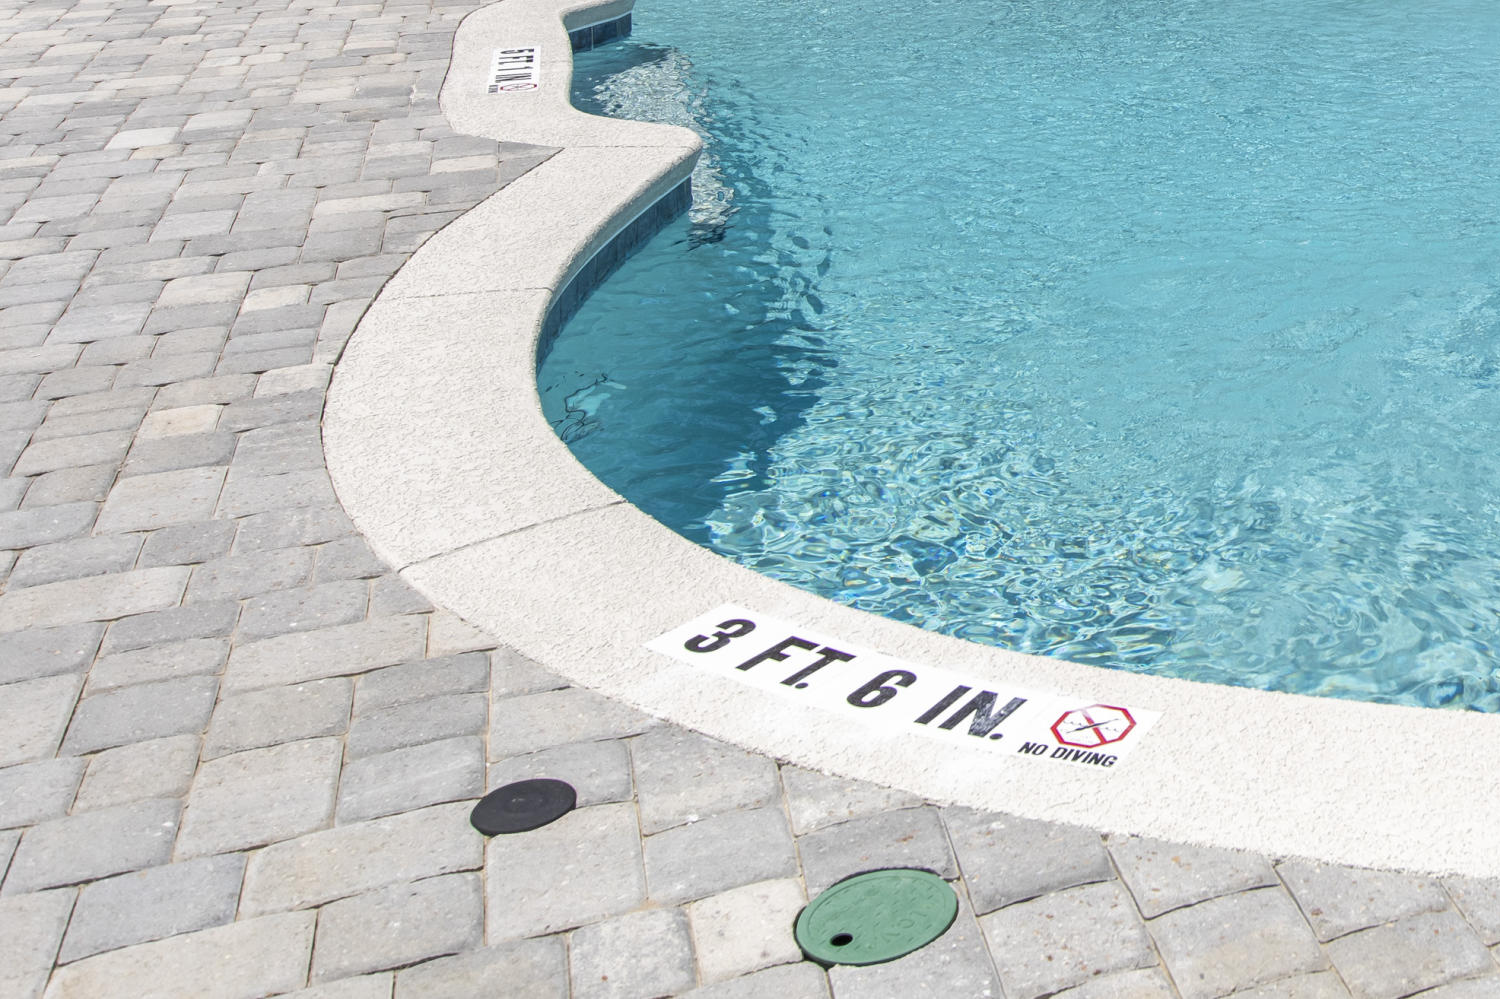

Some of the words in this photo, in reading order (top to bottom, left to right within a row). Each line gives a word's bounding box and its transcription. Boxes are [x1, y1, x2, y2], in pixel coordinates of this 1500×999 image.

[684, 618, 757, 653] 3
[735, 635, 857, 690] FT.
[846, 669, 918, 708] 6
[914, 684, 1028, 741] IN.
[1017, 741, 1049, 756] NO
[1049, 746, 1118, 768] DIVING
